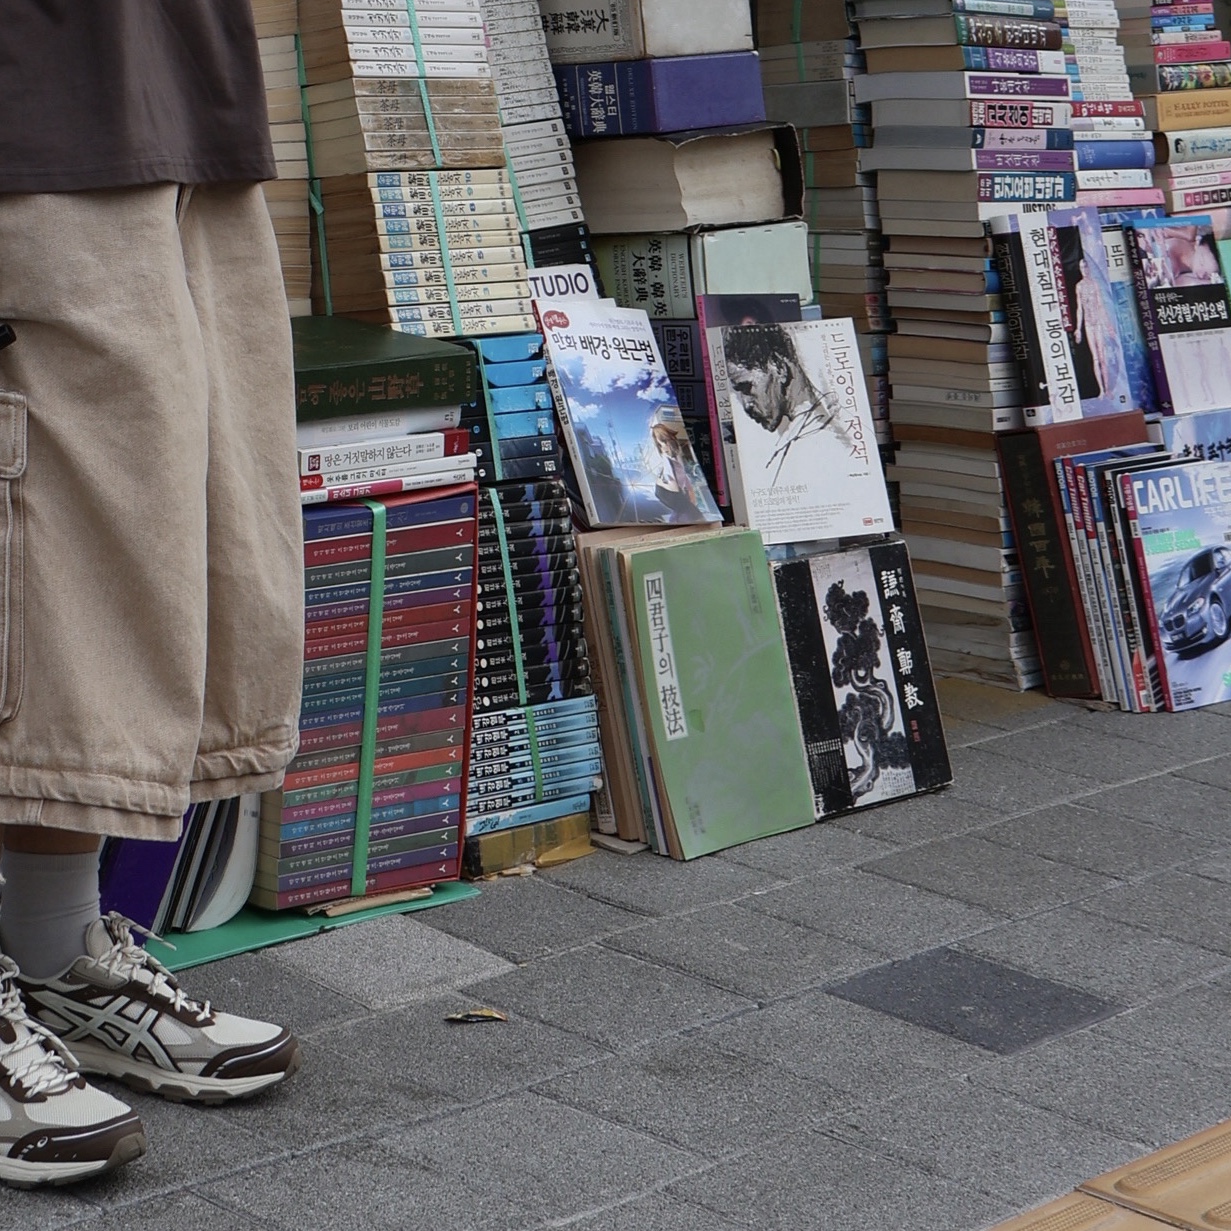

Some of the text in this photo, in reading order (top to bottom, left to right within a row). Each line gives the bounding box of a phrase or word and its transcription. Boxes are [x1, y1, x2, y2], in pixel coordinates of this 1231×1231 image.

[527, 272, 589, 298] TUDIO
[670, 253, 679, 299] DICTIONARY
[551, 331, 577, 351] 만화
[1029, 228, 1075, 404] 현대침구 동의보감
[830, 332, 869, 465] 드로잉의 정석
[342, 447, 385, 466] 거짓말하지
[386, 443, 413, 460] 않는다
[1076, 474, 1093, 533] Car Tuning
[645, 576, 685, 737] 四君子의 技法
